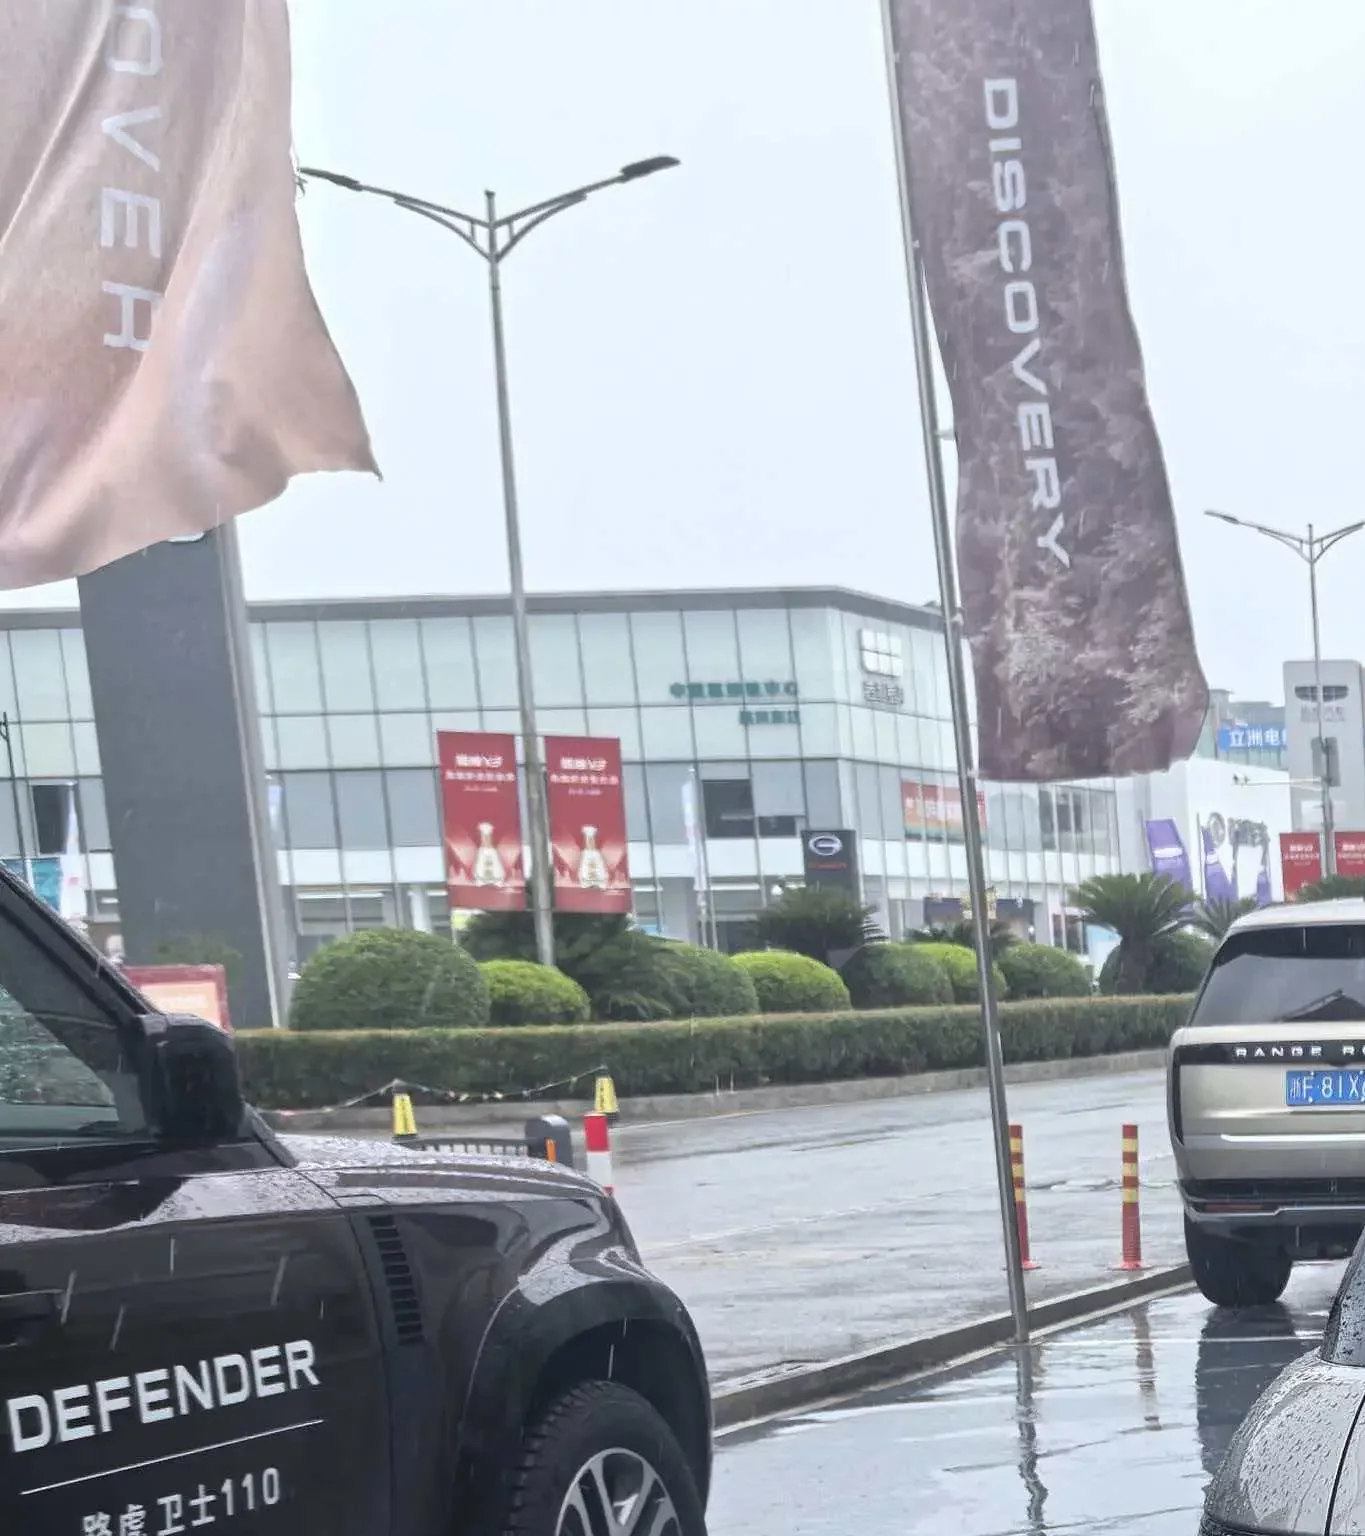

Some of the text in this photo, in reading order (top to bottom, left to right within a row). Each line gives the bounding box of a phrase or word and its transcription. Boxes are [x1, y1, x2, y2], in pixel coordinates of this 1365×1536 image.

[983, 77, 1072, 569] DISCOVERY
[1229, 727, 1287, 747] 立洲电
[1236, 1046, 1322, 1057] RANGE
[8, 1340, 320, 1452] DEFENDER
